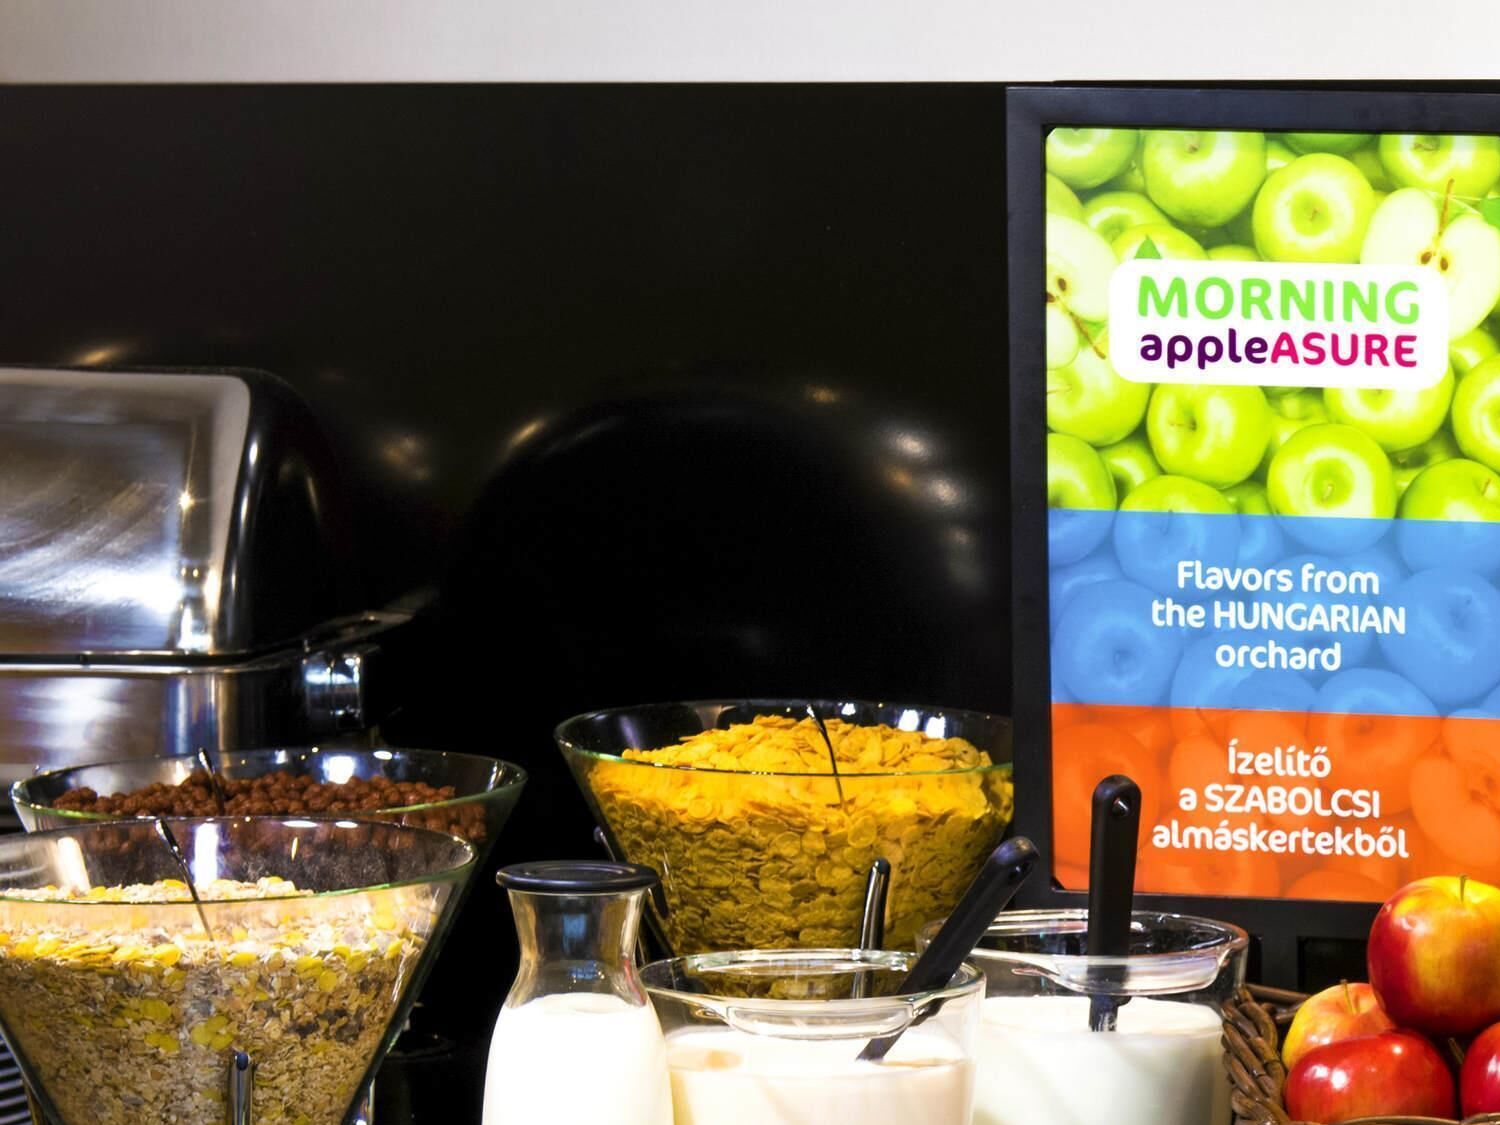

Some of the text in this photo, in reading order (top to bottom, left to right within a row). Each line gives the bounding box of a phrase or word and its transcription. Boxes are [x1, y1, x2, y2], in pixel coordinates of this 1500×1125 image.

[1136, 274, 1420, 324] MORNING
[1140, 327, 1418, 370] appleASURE
[1177, 560, 1379, 595] Flavors from
[1151, 598, 1405, 634] the HUNGARIAN
[1215, 640, 1341, 671] orchard
[1227, 738, 1331, 777] Ízelítő
[1179, 783, 1380, 818] a SZABOLCSI
[1151, 820, 1408, 858] almáskertekből
